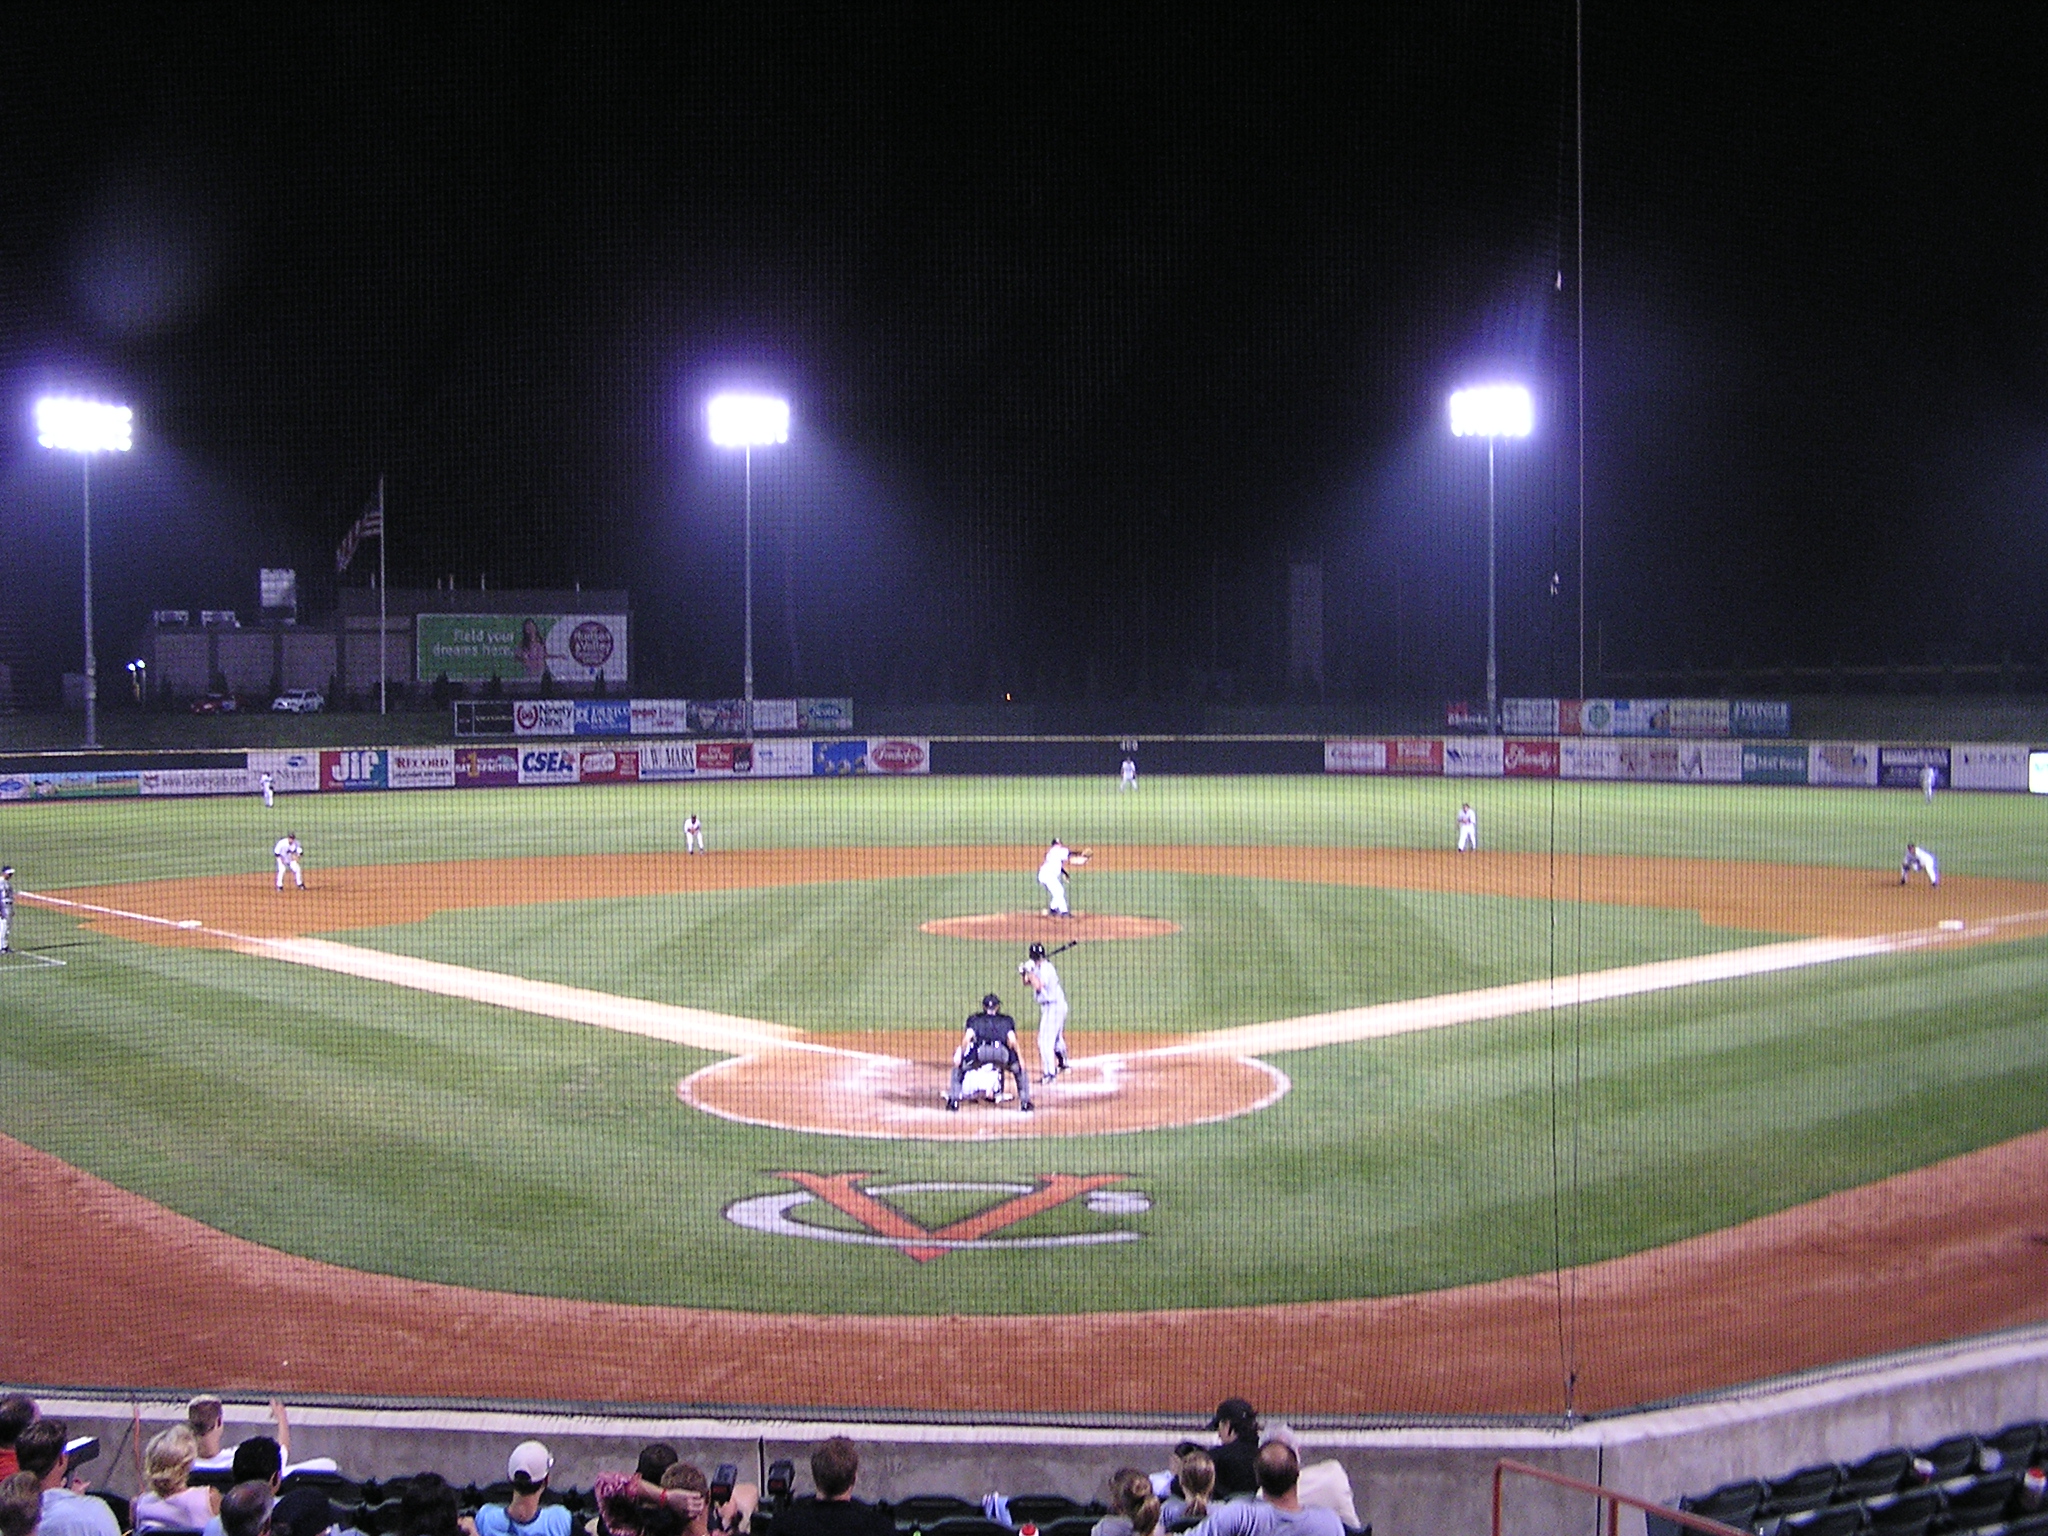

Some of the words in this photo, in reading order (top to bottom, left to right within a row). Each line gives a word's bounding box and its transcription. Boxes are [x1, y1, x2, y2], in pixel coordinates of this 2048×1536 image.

[538, 704, 572, 719] Ninety
[538, 717, 563, 727] Nine
[1120, 742, 1138, 761] 400
[396, 756, 449, 769] RECORD
[522, 751, 574, 773] CSEA
